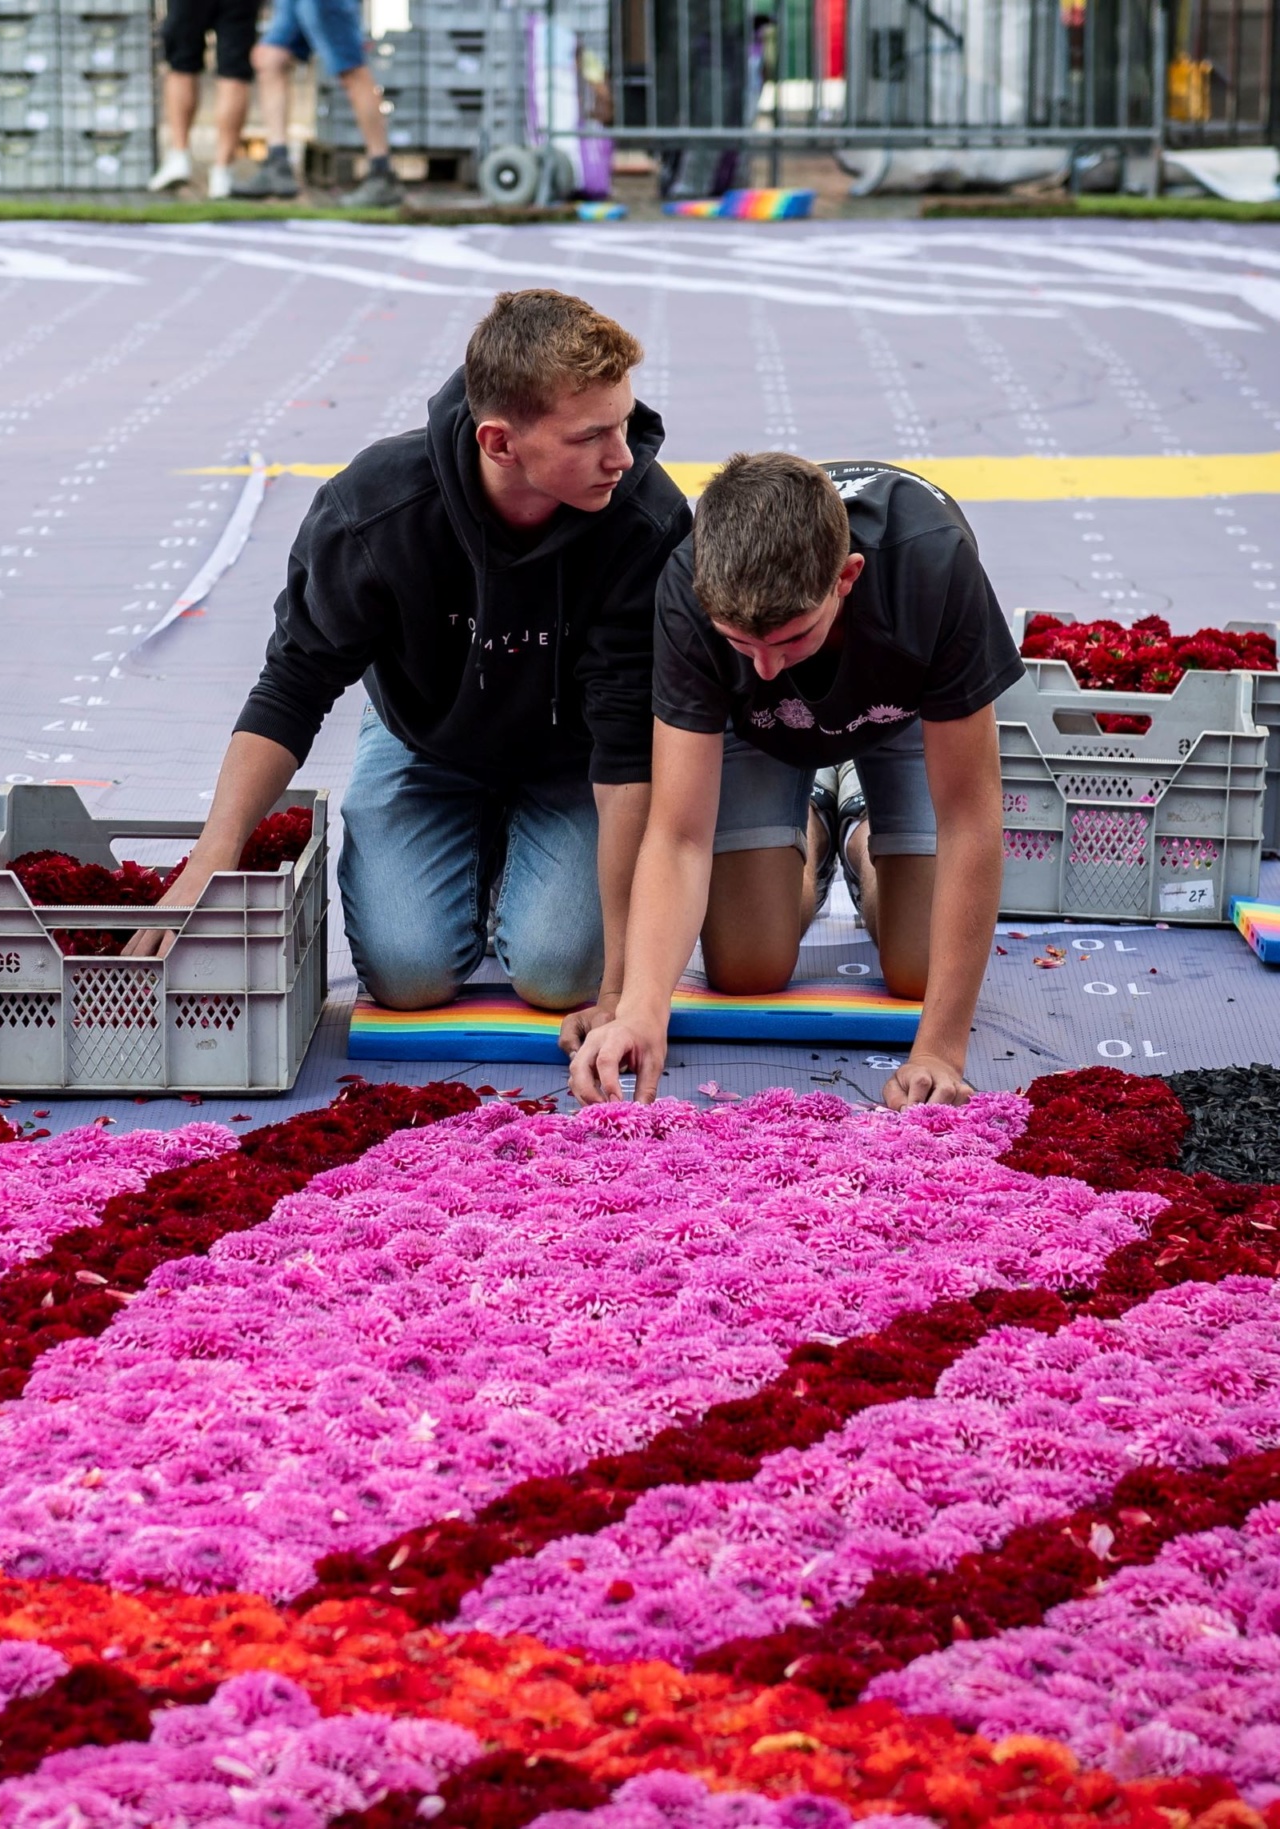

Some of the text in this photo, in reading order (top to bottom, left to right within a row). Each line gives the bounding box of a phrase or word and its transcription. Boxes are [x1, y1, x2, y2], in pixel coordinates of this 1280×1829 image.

[1188, 889, 1208, 903] 27
[1070, 938, 1138, 953] 10
[1082, 981, 1152, 996] 10
[1096, 1039, 1168, 1059] 10
